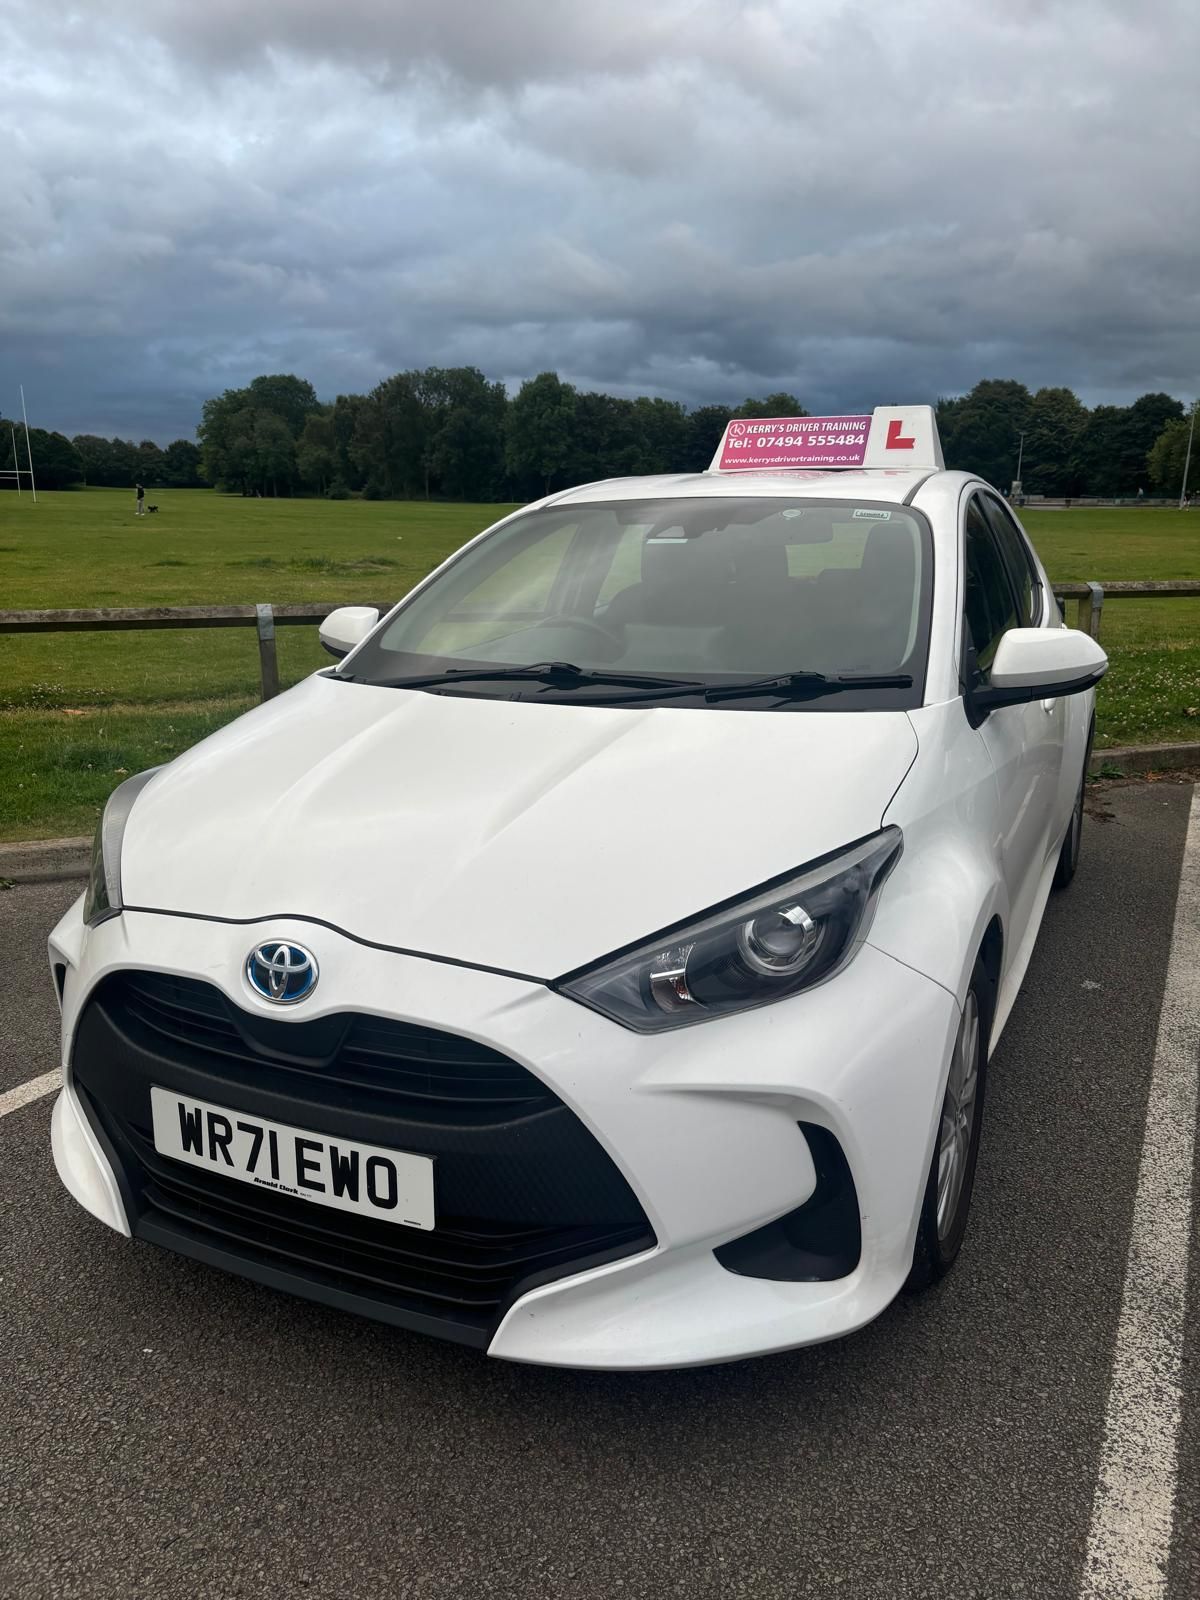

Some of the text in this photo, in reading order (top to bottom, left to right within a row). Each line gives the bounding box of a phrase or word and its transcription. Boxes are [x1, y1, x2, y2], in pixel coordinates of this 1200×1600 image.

[746, 423, 785, 434] KERRY'S
[786, 422, 820, 433] DRIVER
[821, 421, 867, 432] TRAINING
[885, 420, 915, 449] L
[728, 434, 865, 449] Tel: 07494 555484
[725, 454, 860, 465] www.kerrysdrivertraining.co.uk
[177, 1101, 398, 1210] WR71 EWO
